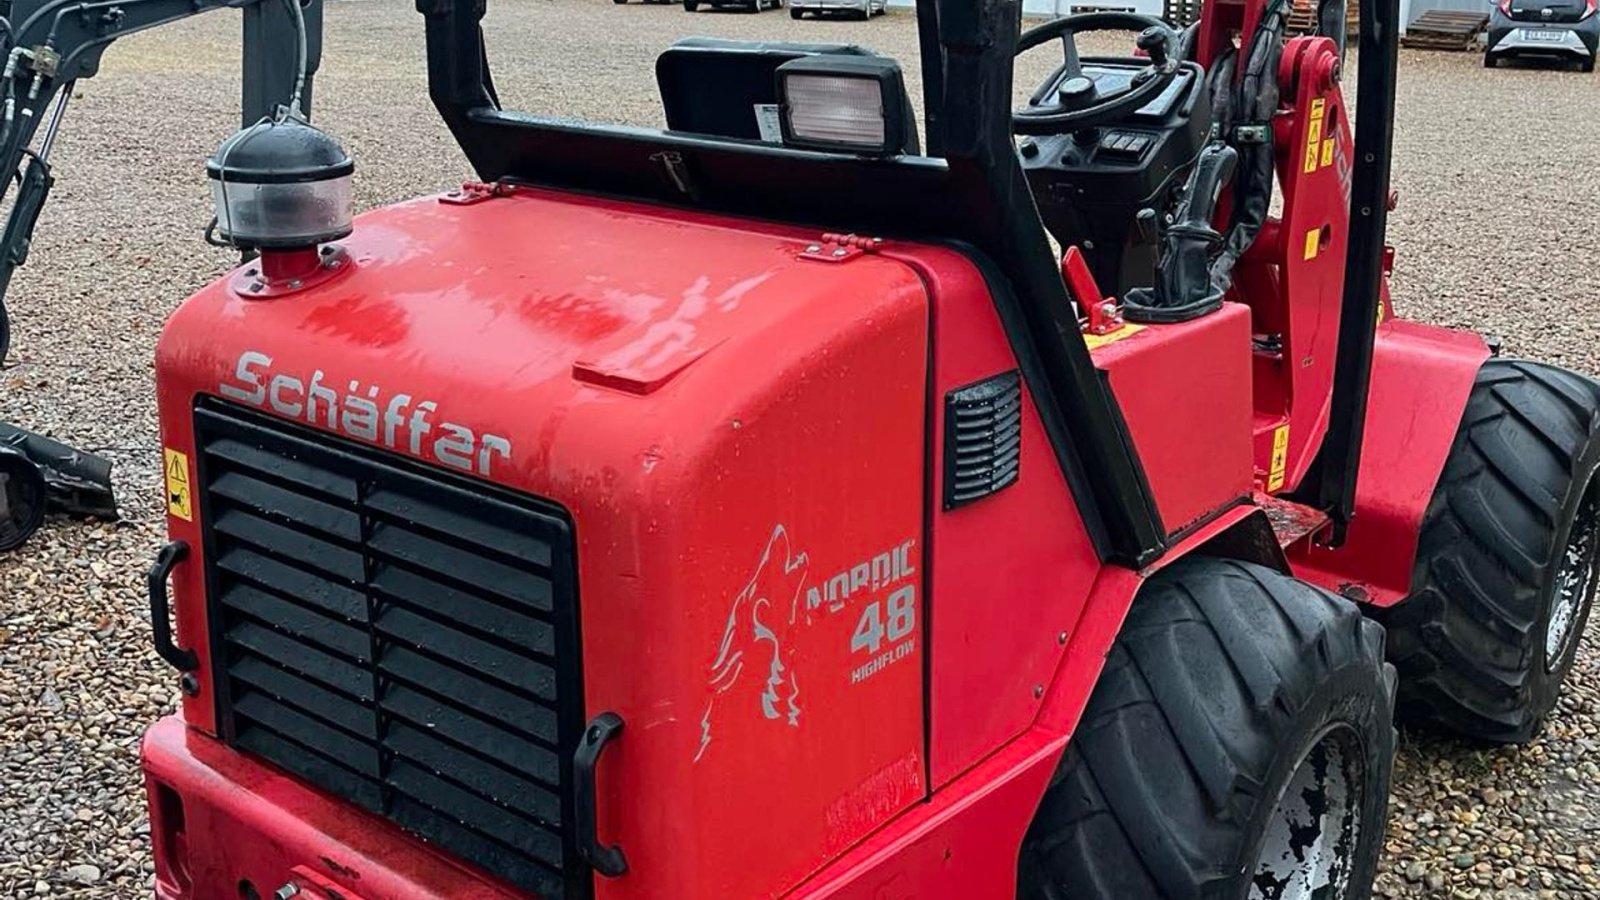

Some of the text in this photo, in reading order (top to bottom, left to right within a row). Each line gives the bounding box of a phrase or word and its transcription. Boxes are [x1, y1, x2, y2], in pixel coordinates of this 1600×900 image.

[219, 351, 512, 476] Schäffer
[851, 584, 916, 654] 48
[851, 638, 916, 684] HIGHFLOW
